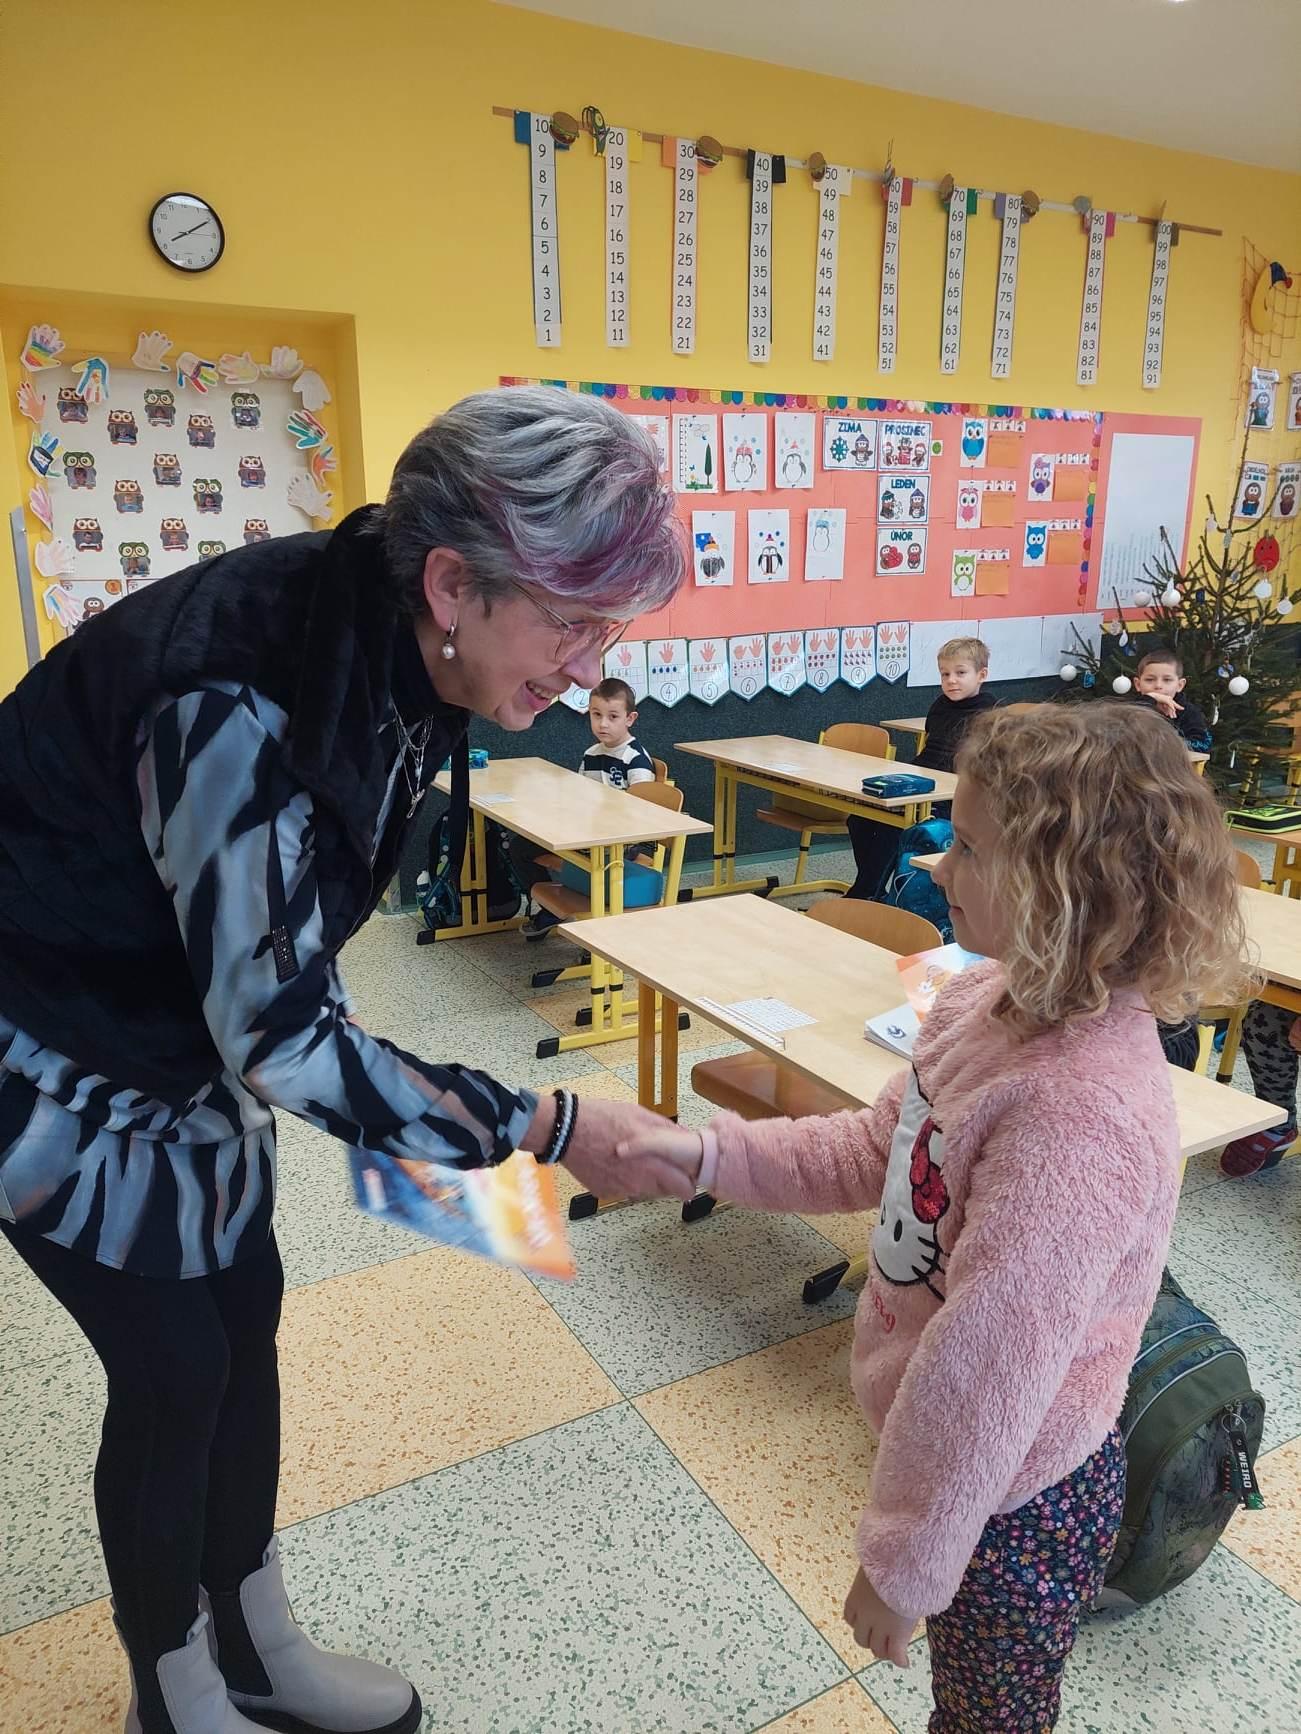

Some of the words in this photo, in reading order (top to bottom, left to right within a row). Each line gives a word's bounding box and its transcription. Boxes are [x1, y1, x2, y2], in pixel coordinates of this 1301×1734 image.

[535, 119, 549, 133] 10
[609, 132, 624, 145] 20
[538, 144, 546, 157] 9
[680, 145, 695, 158] 30
[610, 156, 623, 169] 19
[756, 159, 769, 171] 40
[539, 170, 547, 183] 8
[679, 168, 694, 181] 29
[825, 168, 837, 180] 50
[610, 181, 623, 194] 18
[755, 180, 768, 192] 39
[679, 190, 694, 202] 28
[824, 189, 836, 200] 49
[953, 190, 964, 202] 70
[540, 195, 548, 207] 7
[1008, 199, 1019, 210] 80
[610, 205, 624, 218] 17
[754, 202, 768, 214] 38
[889, 201, 899, 213] 59
[678, 211, 694, 223] 27
[822, 210, 835, 221] 48
[951, 211, 963, 221] 69
[1094, 215, 1104, 226] 90
[541, 217, 549, 230] 6
[888, 222, 897, 234] 58
[1006, 217, 1017, 228] 79
[610, 229, 623, 242] 16
[754, 224, 768, 236] 37
[821, 229, 834, 241] 47
[678, 233, 693, 245] 26
[950, 231, 961, 241] 68
[1092, 233, 1102, 244] 89
[541, 241, 549, 254] 5
[1005, 237, 1016, 248] 78
[1158, 242, 1168, 252] 99
[753, 245, 767, 257] 36
[886, 243, 896, 254] 57
[950, 249, 961, 259] 67
[611, 252, 625, 264] 15
[678, 254, 693, 266] 25
[820, 249, 832, 260] 46
[1090, 250, 1101, 260] 88
[1003, 256, 1015, 267] 77
[1156, 260, 1166, 270] 98
[541, 265, 550, 277] 4
[753, 266, 767, 278] 35
[819, 268, 832, 279] 45
[885, 264, 895, 275] 56
[948, 268, 960, 279] 66
[1089, 268, 1100, 278] 87
[610, 272, 624, 284] 14
[677, 275, 692, 287] 24
[1002, 273, 1013, 284] 76
[1154, 277, 1165, 287] 97
[543, 288, 551, 299] 3
[752, 286, 767, 297] 34
[819, 286, 831, 297] 44
[883, 284, 895, 295] 55
[947, 288, 959, 298] 65
[1087, 285, 1099, 295] 86
[611, 291, 624, 303] 13
[677, 296, 692, 307] 23
[1000, 292, 1012, 302] 75
[1152, 295, 1163, 305] 96
[752, 307, 767, 318] 33
[818, 306, 831, 316] 43
[882, 305, 894, 316] 54
[947, 305, 959, 316] 64
[1086, 303, 1098, 313] 85
[543, 310, 551, 322] 2
[611, 310, 625, 322] 12
[999, 311, 1011, 321] 74
[1150, 312, 1161, 322] 95
[676, 317, 692, 328] 22
[1084, 322, 1096, 332] 84
[545, 329, 551, 341] 1
[612, 329, 623, 341] 11
[752, 327, 766, 338] 32
[817, 325, 831, 336] 42
[882, 325, 894, 336] 53
[945, 325, 957, 335] 63
[998, 329, 1009, 340] 73
[1150, 327, 1160, 337] 94
[677, 337, 690, 349] 21
[882, 343, 894, 353] 52
[945, 343, 957, 354] 62
[1082, 340, 1095, 350] 83
[753, 345, 766, 356] 31
[817, 344, 829, 355] 41
[996, 348, 1009, 358] 72
[1148, 344, 1159, 354] 93
[882, 359, 892, 369] 51
[944, 359, 955, 369] 61
[1081, 356, 1095, 366] 82
[1146, 360, 1158, 370] 92
[995, 364, 1007, 373] 71
[1081, 370, 1093, 380] 81
[1146, 374, 1157, 384] 91
[838, 422, 862, 433] ZIMA
[885, 424, 926, 436] PROSINEC
[891, 478, 916, 489] LEDEN
[891, 529, 913, 541] ÚNOR
